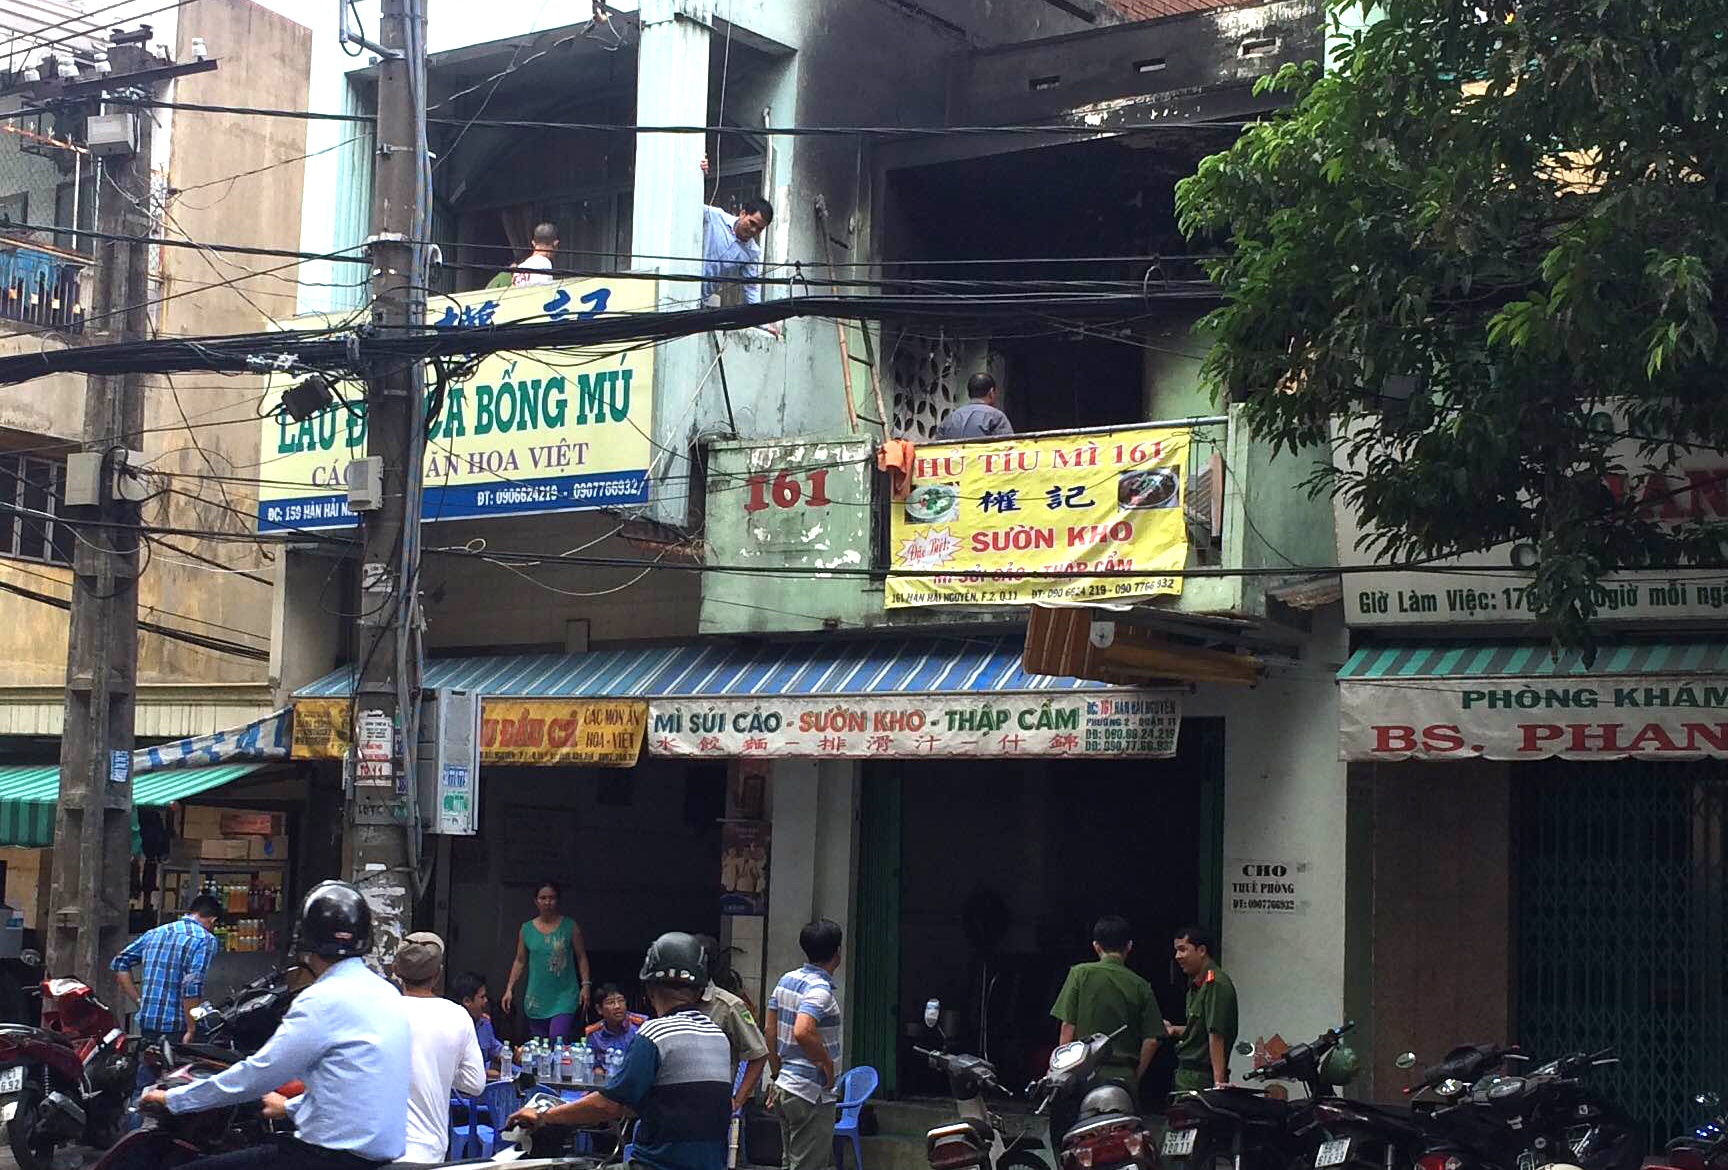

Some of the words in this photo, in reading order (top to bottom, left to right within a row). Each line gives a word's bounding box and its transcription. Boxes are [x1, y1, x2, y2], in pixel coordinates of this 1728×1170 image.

[474, 361, 568, 435] BỐNG
[577, 353, 633, 425] MÚ
[425, 448, 460, 478] ĂN
[467, 448, 520, 475] HOA
[528, 438, 590, 473] VIỆT
[977, 445, 1041, 474] TÍU
[1051, 441, 1098, 469] MÌ
[1112, 441, 1164, 464] 161
[744, 468, 831, 512] 161
[970, 524, 1055, 552] SƯỜN
[1067, 520, 1133, 548] KHO
[1359, 588, 1389, 615] Giờ
[1398, 587, 1438, 613] Làm
[1447, 587, 1497, 618] Việc:
[1462, 684, 1598, 709] PHÒNG
[1614, 682, 1728, 709] KHÁM
[798, 704, 868, 733] SƯỜN
[873, 708, 927, 732] KHO
[944, 703, 1011, 737] THẬP
[1371, 723, 1486, 753] BS.
[1517, 723, 1728, 753] PHAN
[1242, 864, 1288, 877] CHO
